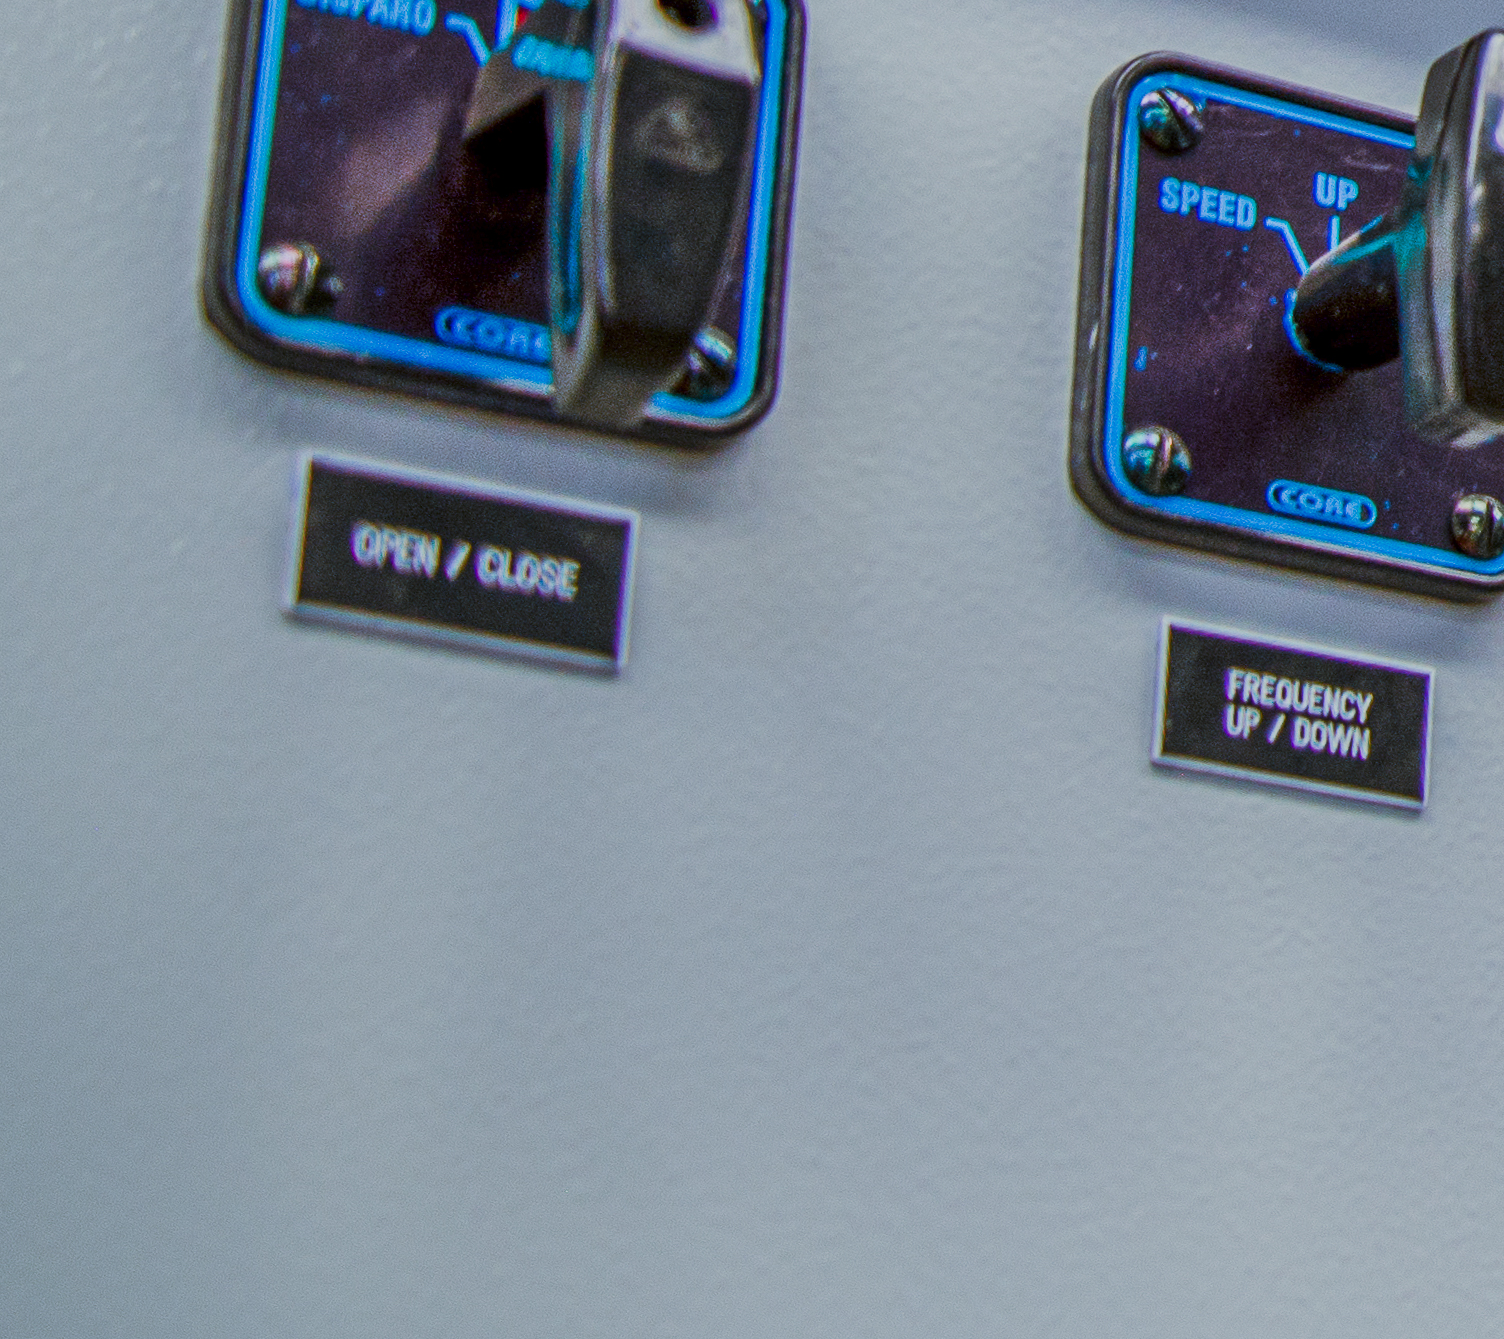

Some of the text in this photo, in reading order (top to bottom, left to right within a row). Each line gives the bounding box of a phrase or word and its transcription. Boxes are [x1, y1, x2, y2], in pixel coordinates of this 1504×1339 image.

[1158, 178, 1258, 231] SPEED
[1312, 170, 1359, 210] UP
[1279, 487, 1361, 522] CORE
[350, 520, 581, 603] OPEN / CLOSE
[1224, 665, 1374, 724] FREQUENCY
[1222, 704, 1371, 761] UP / DOWN
